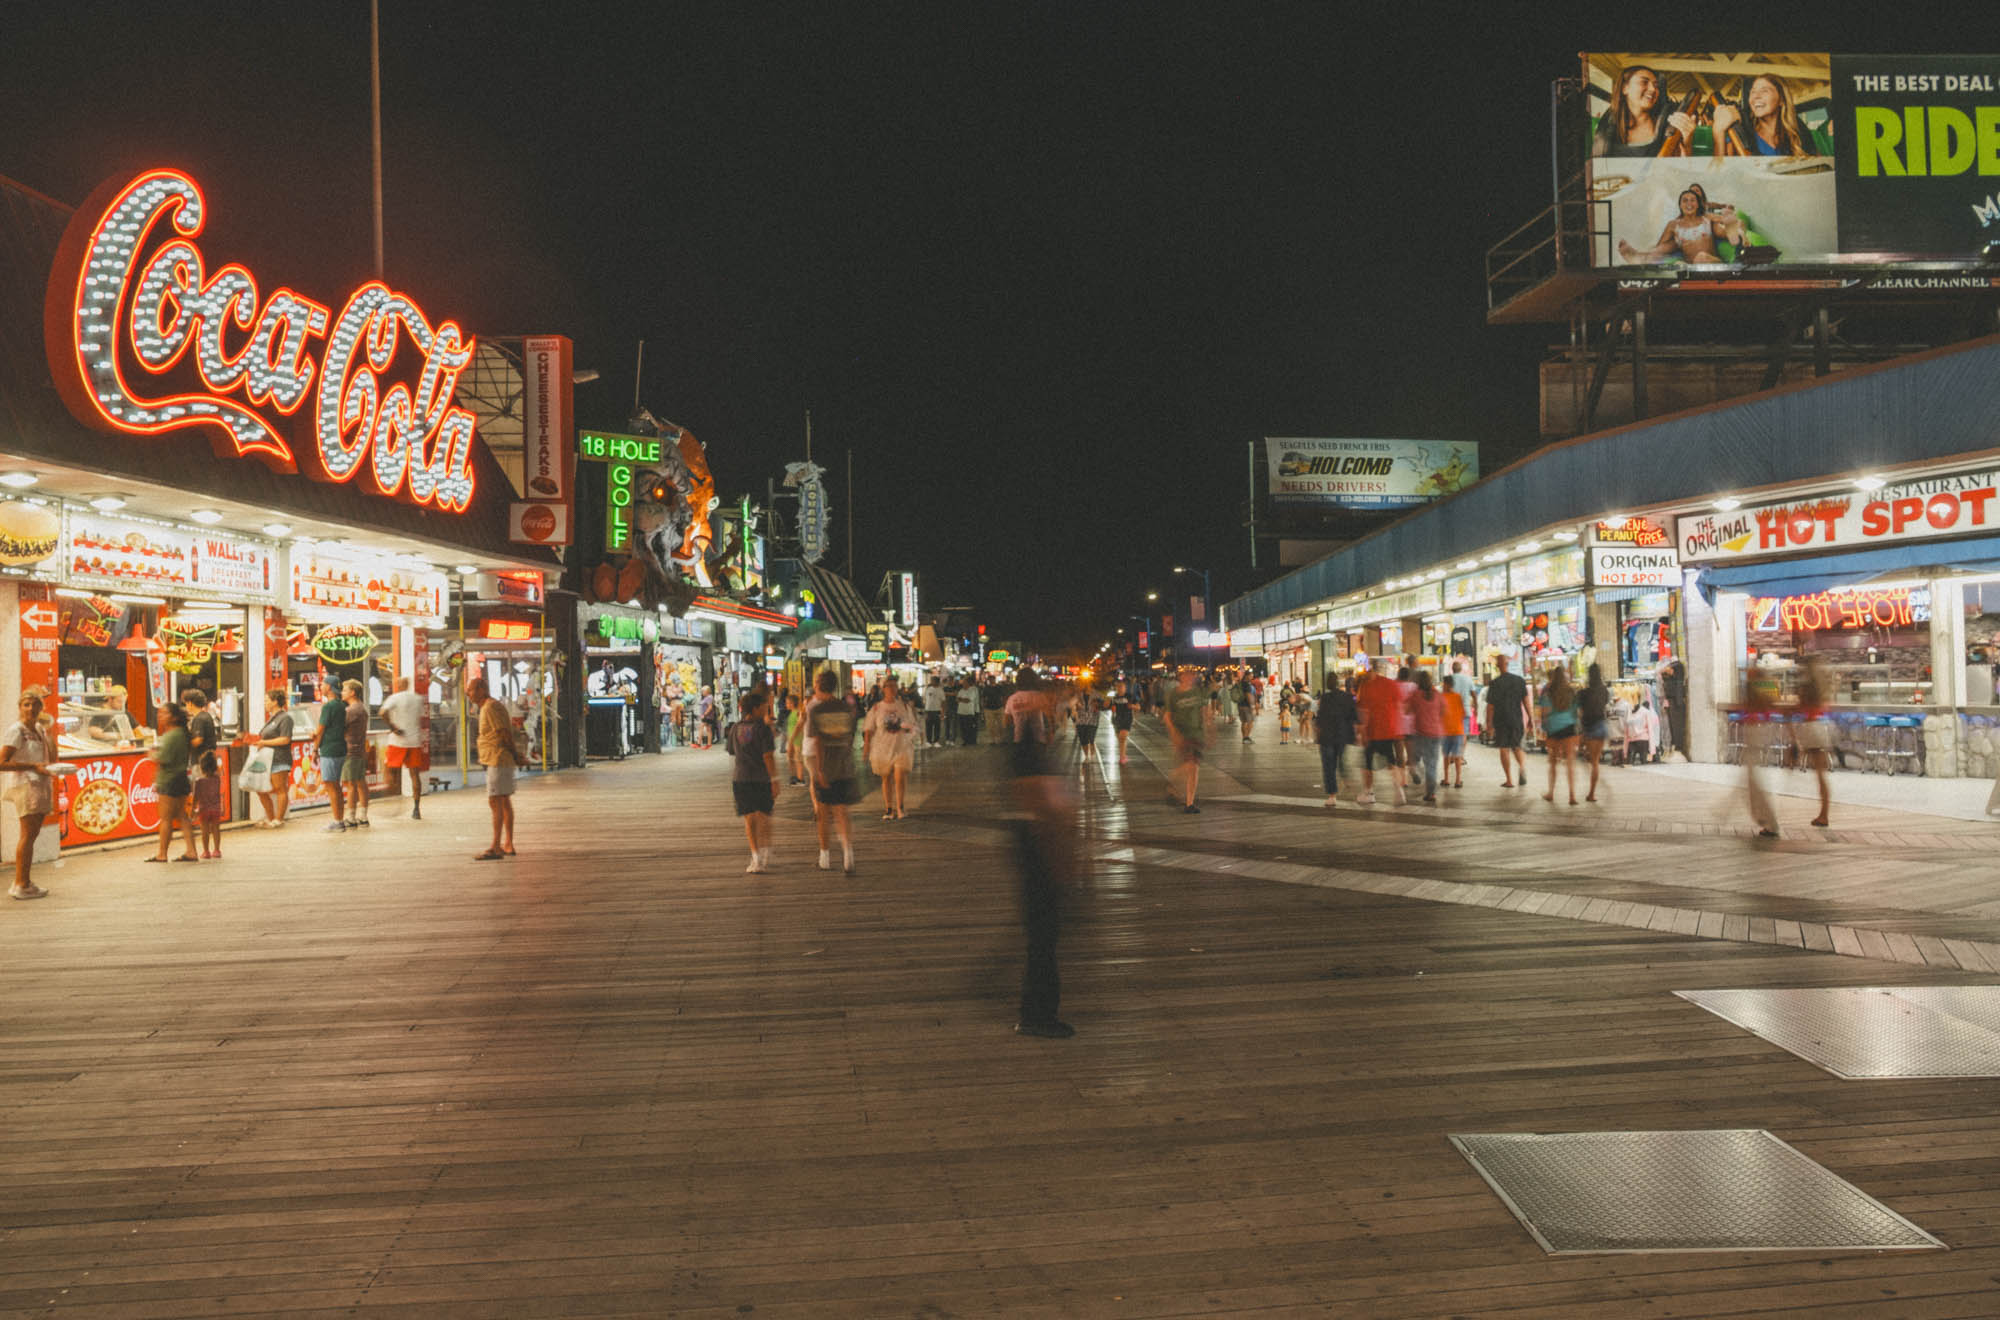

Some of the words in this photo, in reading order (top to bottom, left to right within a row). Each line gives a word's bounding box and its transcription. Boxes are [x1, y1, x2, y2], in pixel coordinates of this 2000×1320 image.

[1853, 75, 1890, 92] THE
[1895, 75, 1940, 92] BEST
[1945, 75, 1994, 92] DEAL
[1972, 193, 2000, 228] M
[1866, 277, 1990, 289] LEARCHANNEL
[74, 167, 330, 464] Coca
[316, 279, 477, 513] Cola
[537, 352, 550, 477] CHEESESTEAKS
[582, 435, 606, 457] 18
[609, 438, 661, 462] HOLE
[1318, 441, 1337, 450] NEED
[1308, 455, 1394, 476] HOLCOMB
[1280, 480, 1325, 492] NEEDS
[1326, 480, 1388, 493] DRIVERS!
[1868, 472, 1996, 504] RESTAURANT
[612, 465, 631, 549] GOLF
[1757, 500, 1846, 550] HOT
[1861, 487, 1997, 538] SPOT
[1599, 529, 1639, 542] PEANUT
[1638, 528, 1665, 546] FREE
[1686, 515, 1752, 557] ORIGINAL
[1695, 516, 1714, 533] THE
[206, 538, 256, 565] WALLS
[1600, 554, 1676, 571] ORIGINAL
[1600, 573, 1628, 584] HOT
[1631, 573, 1664, 584] SPOT
[1784, 600, 1833, 631] HOT
[1839, 595, 1909, 628] SPOT
[76, 761, 122, 788] PIZZA
